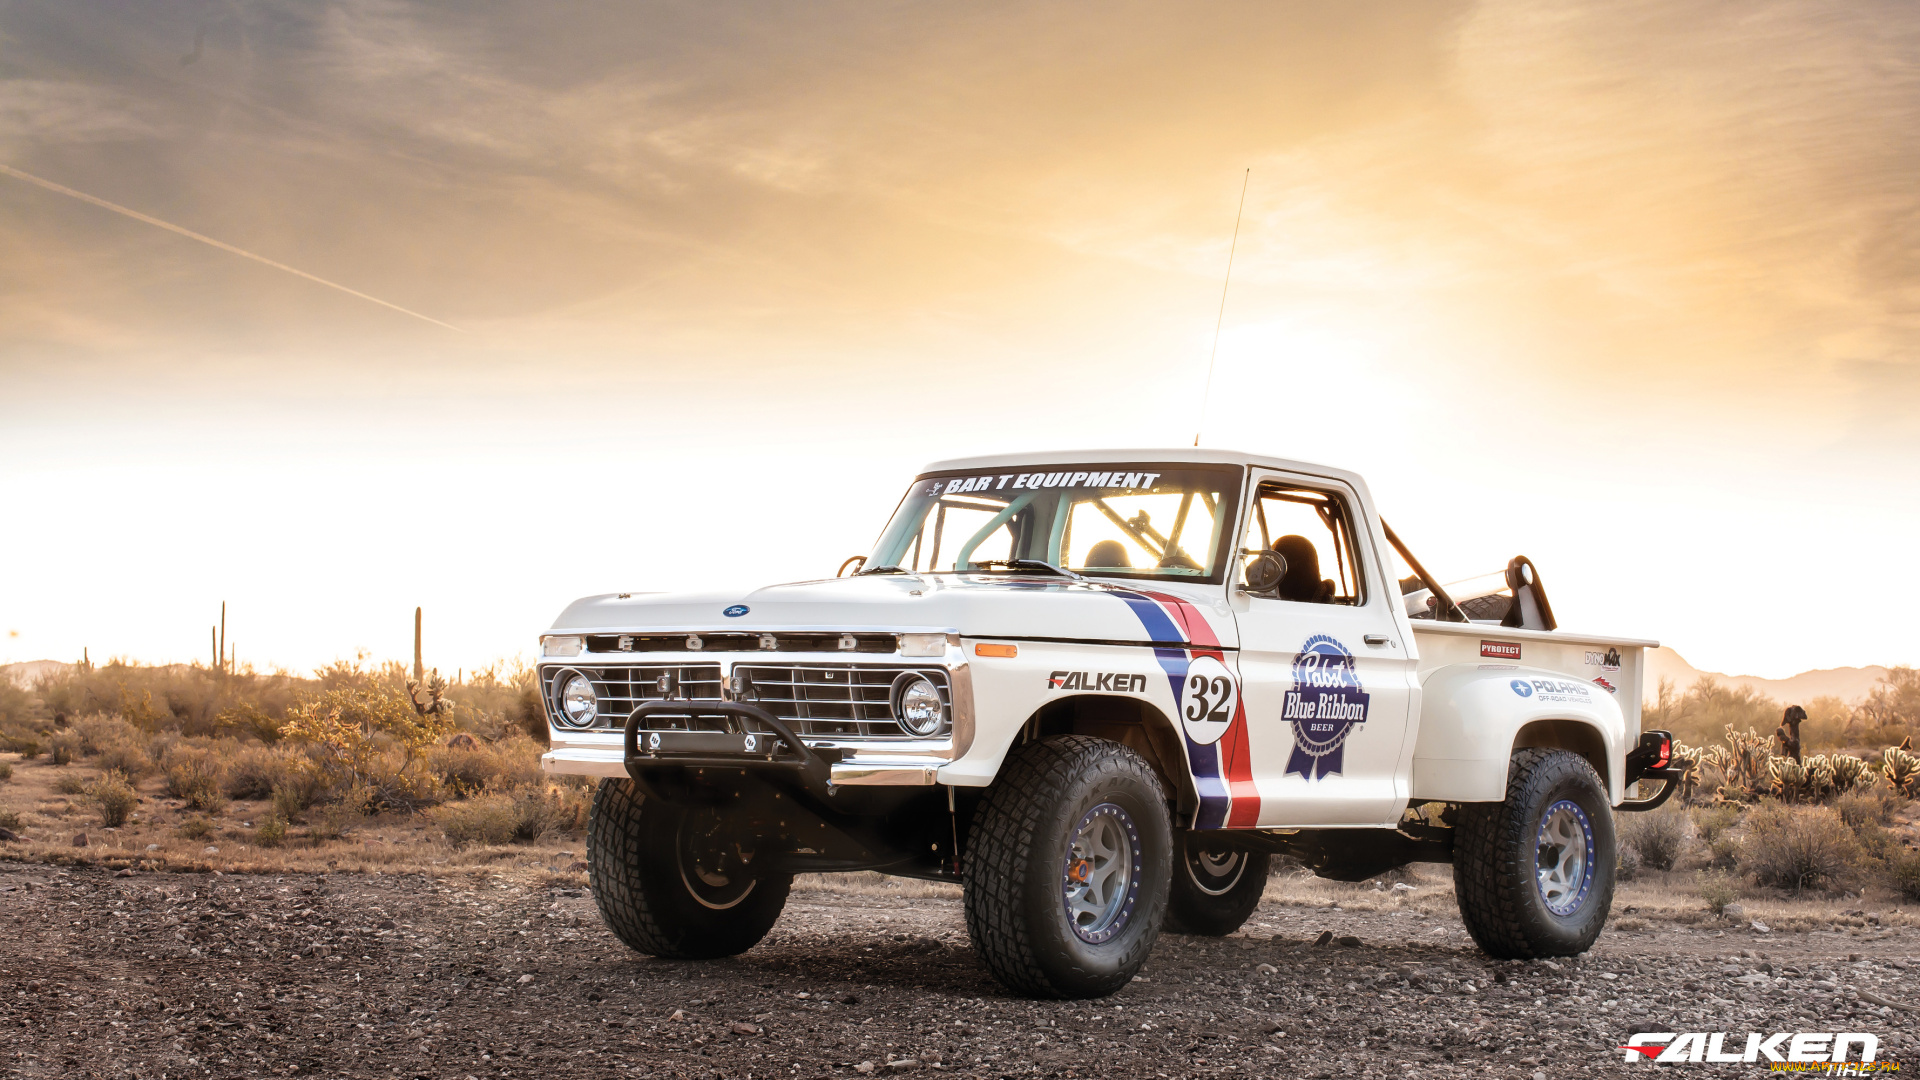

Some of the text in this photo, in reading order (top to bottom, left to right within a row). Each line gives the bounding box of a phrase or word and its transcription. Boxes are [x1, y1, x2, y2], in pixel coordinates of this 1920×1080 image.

[943, 476, 993, 494] BAR
[995, 474, 1014, 490] T
[1012, 472, 1161, 490] EQUIPMENT
[1481, 644, 1519, 655] PYROTECT
[1302, 651, 1348, 689] Pabst
[1046, 671, 1147, 693] FALKEN
[1531, 680, 1589, 696] POLARIS
[1186, 674, 1232, 723] 32
[1284, 692, 1365, 721] Blue Ribbon
[1310, 723, 1334, 732] BEER
